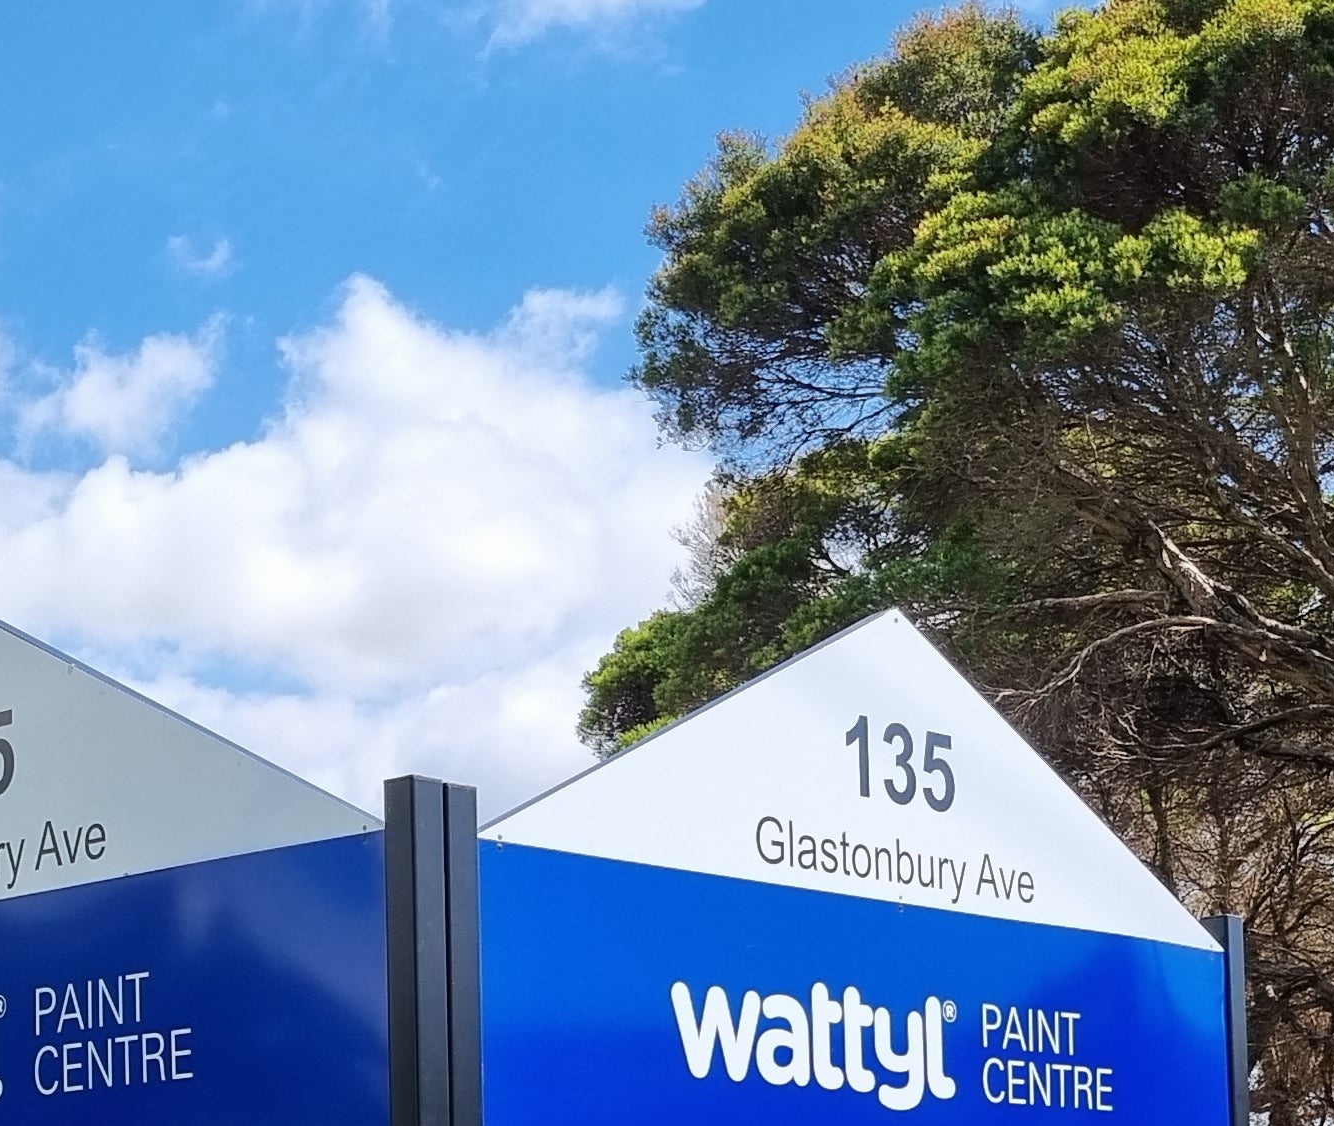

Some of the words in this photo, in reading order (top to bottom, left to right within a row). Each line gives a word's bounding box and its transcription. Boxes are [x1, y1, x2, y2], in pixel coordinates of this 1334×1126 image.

[845, 715, 957, 813] 135
[34, 820, 107, 871] Ave
[755, 815, 967, 905] Glastonbury
[975, 853, 1035, 904] Ave
[34, 971, 151, 1036] PAINT
[982, 1003, 1082, 1056] PAINT
[34, 1028, 194, 1096] CENTRE
[982, 1057, 1114, 1112] CENTRE
